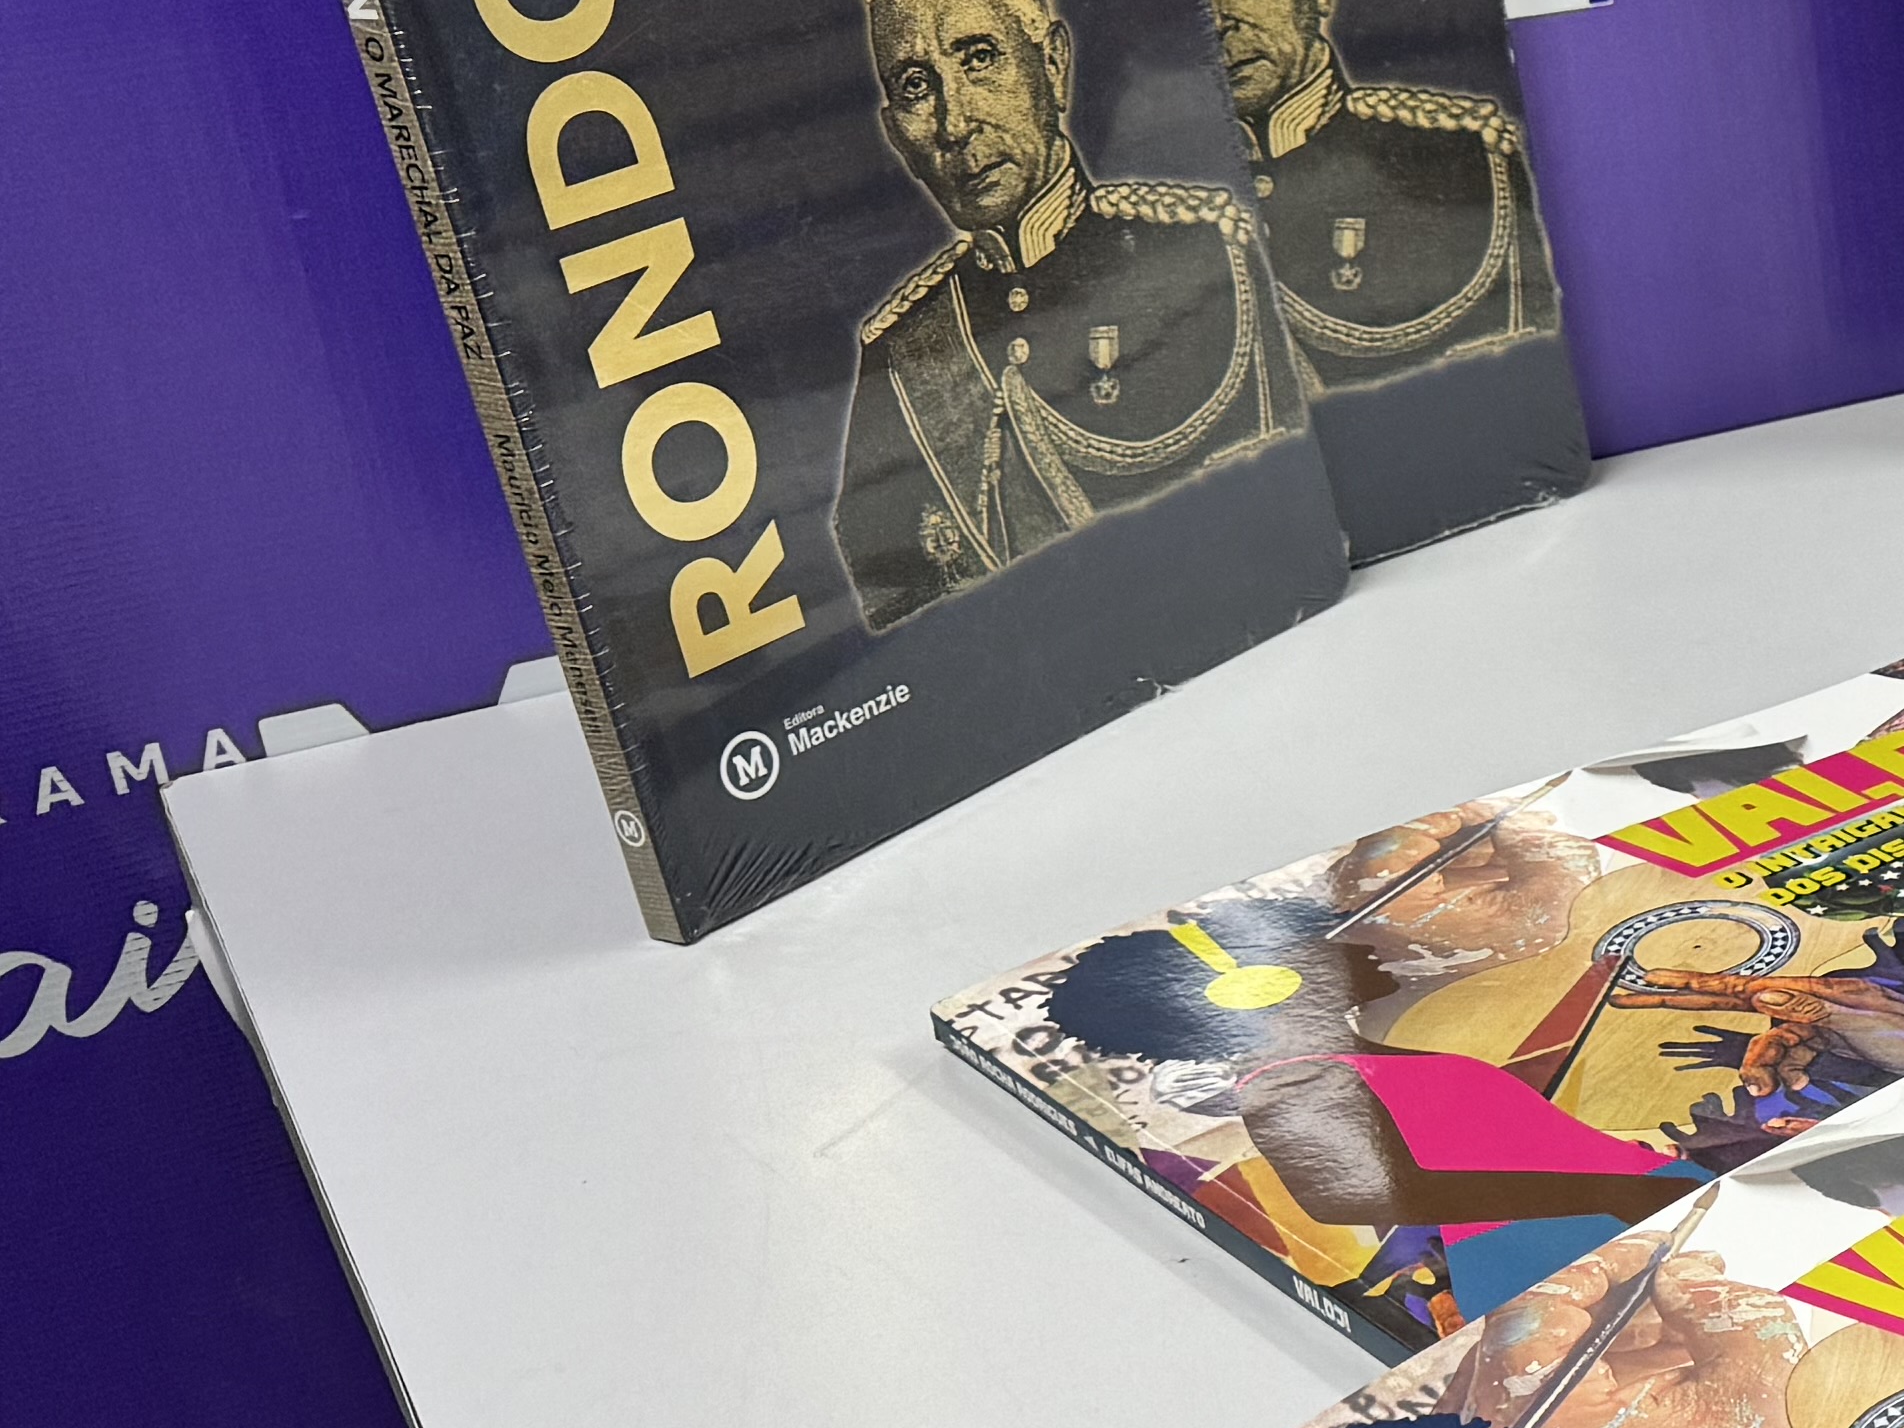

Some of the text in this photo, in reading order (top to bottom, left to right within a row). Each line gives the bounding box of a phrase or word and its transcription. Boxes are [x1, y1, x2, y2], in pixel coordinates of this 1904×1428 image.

[364, 36, 386, 63] O
[373, 71, 437, 245] MARECHAL
[433, 253, 461, 297] DA
[450, 304, 484, 361] PAZ
[783, 704, 825, 731] Editora
[788, 682, 912, 756] Mackenzie
[1714, 868, 1753, 891] O
[1758, 867, 1838, 908] DOS
[1104, 1145, 1143, 1184] ELIFAS
